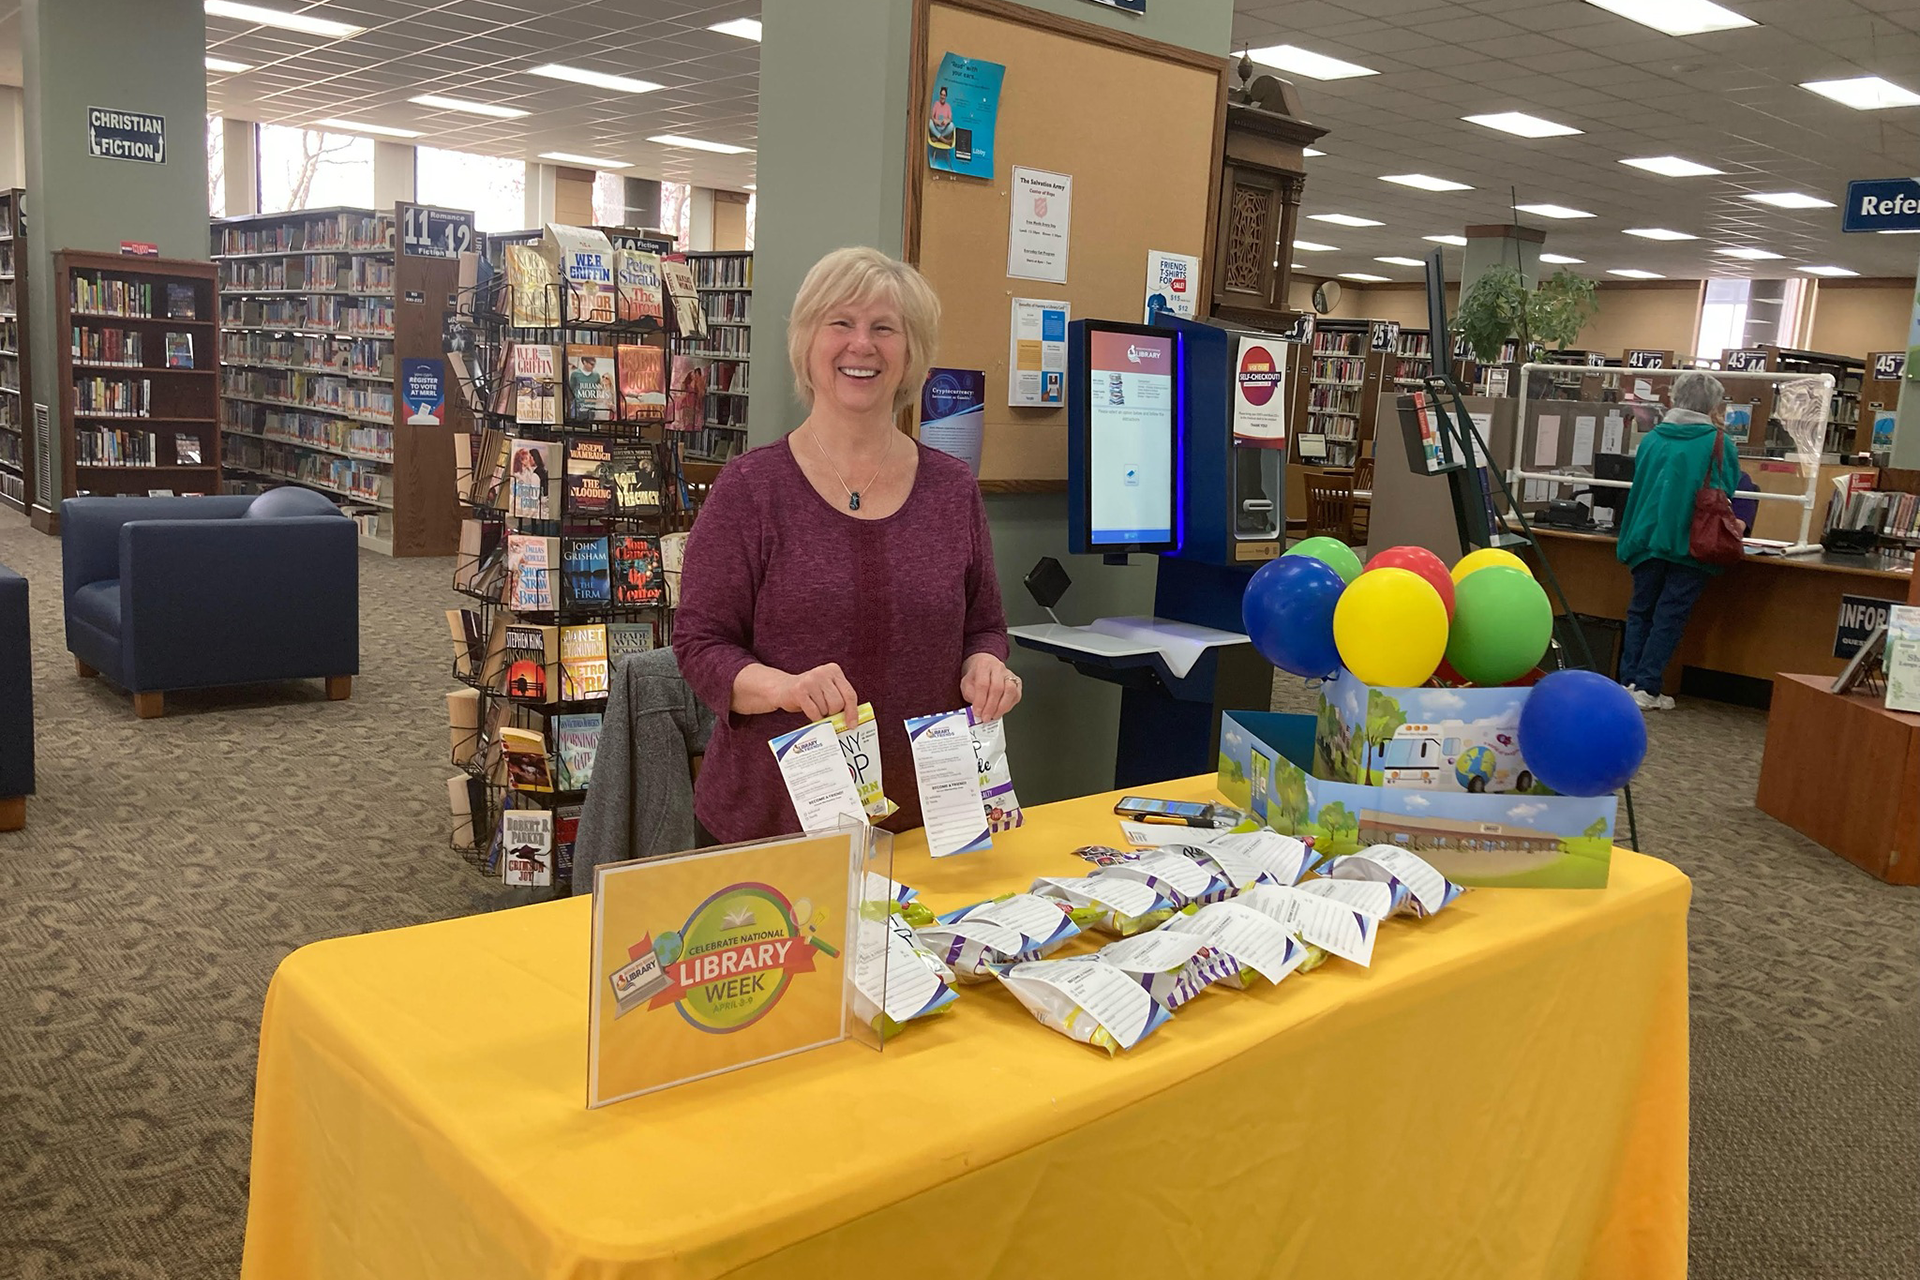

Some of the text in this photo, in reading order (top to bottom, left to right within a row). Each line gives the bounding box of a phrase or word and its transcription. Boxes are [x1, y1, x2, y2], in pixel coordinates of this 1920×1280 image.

[92, 111, 162, 134] CHRISTIAN
[101, 139, 154, 158] FICTION
[972, 147, 986, 156] Libby
[1020, 177, 1065, 191] The Salvation Army
[405, 208, 465, 245] 11 Romance
[445, 223, 471, 258] 12
[637, 241, 659, 249] Fiction
[418, 248, 445, 257] Fiction
[575, 253, 603, 267] W.E.B.
[516, 252, 546, 269] NORA
[625, 257, 655, 273] Peter
[1160, 261, 1187, 271] FRIENDS
[570, 266, 610, 281] GRIFFIN
[619, 270, 661, 288] Straub
[1160, 269, 1187, 279] T-SHIRTS
[571, 293, 611, 309] HONOR
[632, 288, 655, 303] The
[620, 298, 661, 316] Throat
[1373, 324, 1385, 346] 25
[516, 347, 541, 361] W.E.B.
[1135, 351, 1161, 359] LIBRARY
[1629, 352, 1662, 369] 41 42
[518, 359, 553, 374] GRIFFIN
[1728, 352, 1765, 372] 43 44
[1877, 356, 1896, 372] 45
[577, 389, 610, 399] MORRIS
[576, 442, 604, 453] JOSEPH
[570, 450, 611, 461] WAMBAUGH
[582, 479, 599, 488] THE
[616, 491, 660, 507] PRECINCT
[572, 541, 598, 552] JOHN
[624, 537, 648, 550] Tom
[564, 552, 607, 560] GRISHAM
[615, 547, 660, 561] Clancy's
[520, 578, 548, 590] STRAW
[580, 581, 594, 589] THE
[519, 590, 551, 605] BRIDE
[575, 589, 600, 599] FIRM
[617, 585, 661, 602] Center
[506, 631, 544, 650] STEPHEN KING
[564, 629, 604, 642] JANET
[613, 632, 650, 640] TRADE
[563, 642, 604, 658] EVANOVICH
[567, 663, 605, 676] METRO
[798, 740, 818, 749] LIBRARY
[574, 752, 592, 770] GATE
[507, 818, 541, 833] ROBERT
[511, 832, 545, 846] PARKER
[508, 860, 545, 873] CRIMSON
[518, 871, 533, 881] JOY
[689, 930, 784, 956] CELEBRATE NATIONAL
[625, 960, 656, 982] LIBRARY
[680, 941, 793, 987] LIBRARY
[705, 973, 765, 1003] WEEK
[713, 997, 753, 1014] APRIL 3-9
